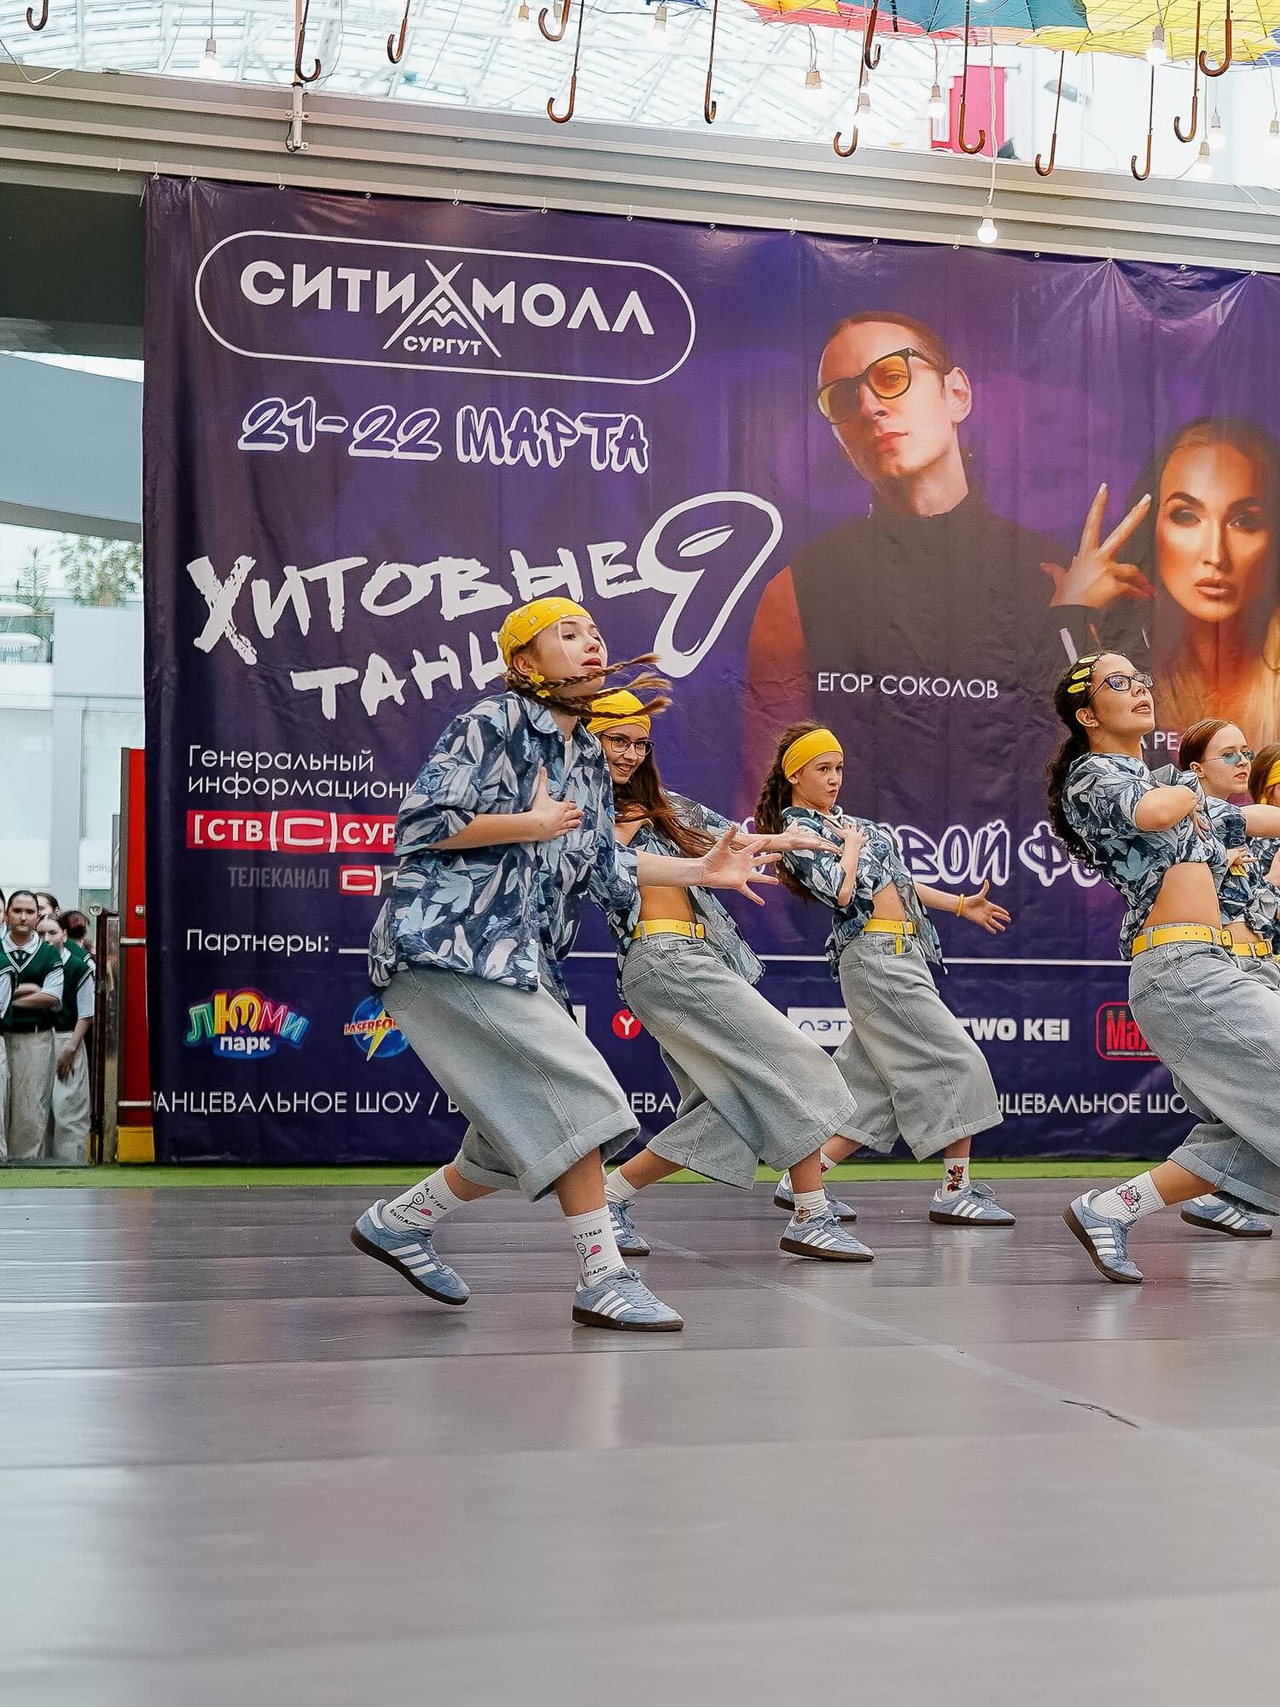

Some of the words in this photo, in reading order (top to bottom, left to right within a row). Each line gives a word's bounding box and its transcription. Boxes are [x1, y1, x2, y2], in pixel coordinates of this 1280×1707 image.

[240, 260, 415, 314] СИТИ
[472, 276, 655, 335] МОЛЛ
[402, 334, 482, 356] СУРГУТ
[237, 396, 442, 461] 21-22
[456, 404, 648, 474] МАРТА
[817, 672, 873, 693] ЕГОР
[879, 674, 999, 699] СОКОЛОВ
[188, 745, 374, 773] Генеральный
[878, 817, 1010, 886] ВОЙ
[227, 866, 330, 888] ТЕЛЕКАНАЛ
[187, 929, 330, 957] Партнеры:
[186, 991, 309, 1043] ЛЮМИ
[1023, 1018, 1070, 1041] KEI
[219, 1035, 271, 1055] парк
[355, 1091, 421, 1114] ШОУ
[1147, 1093, 1191, 1114] ШО
